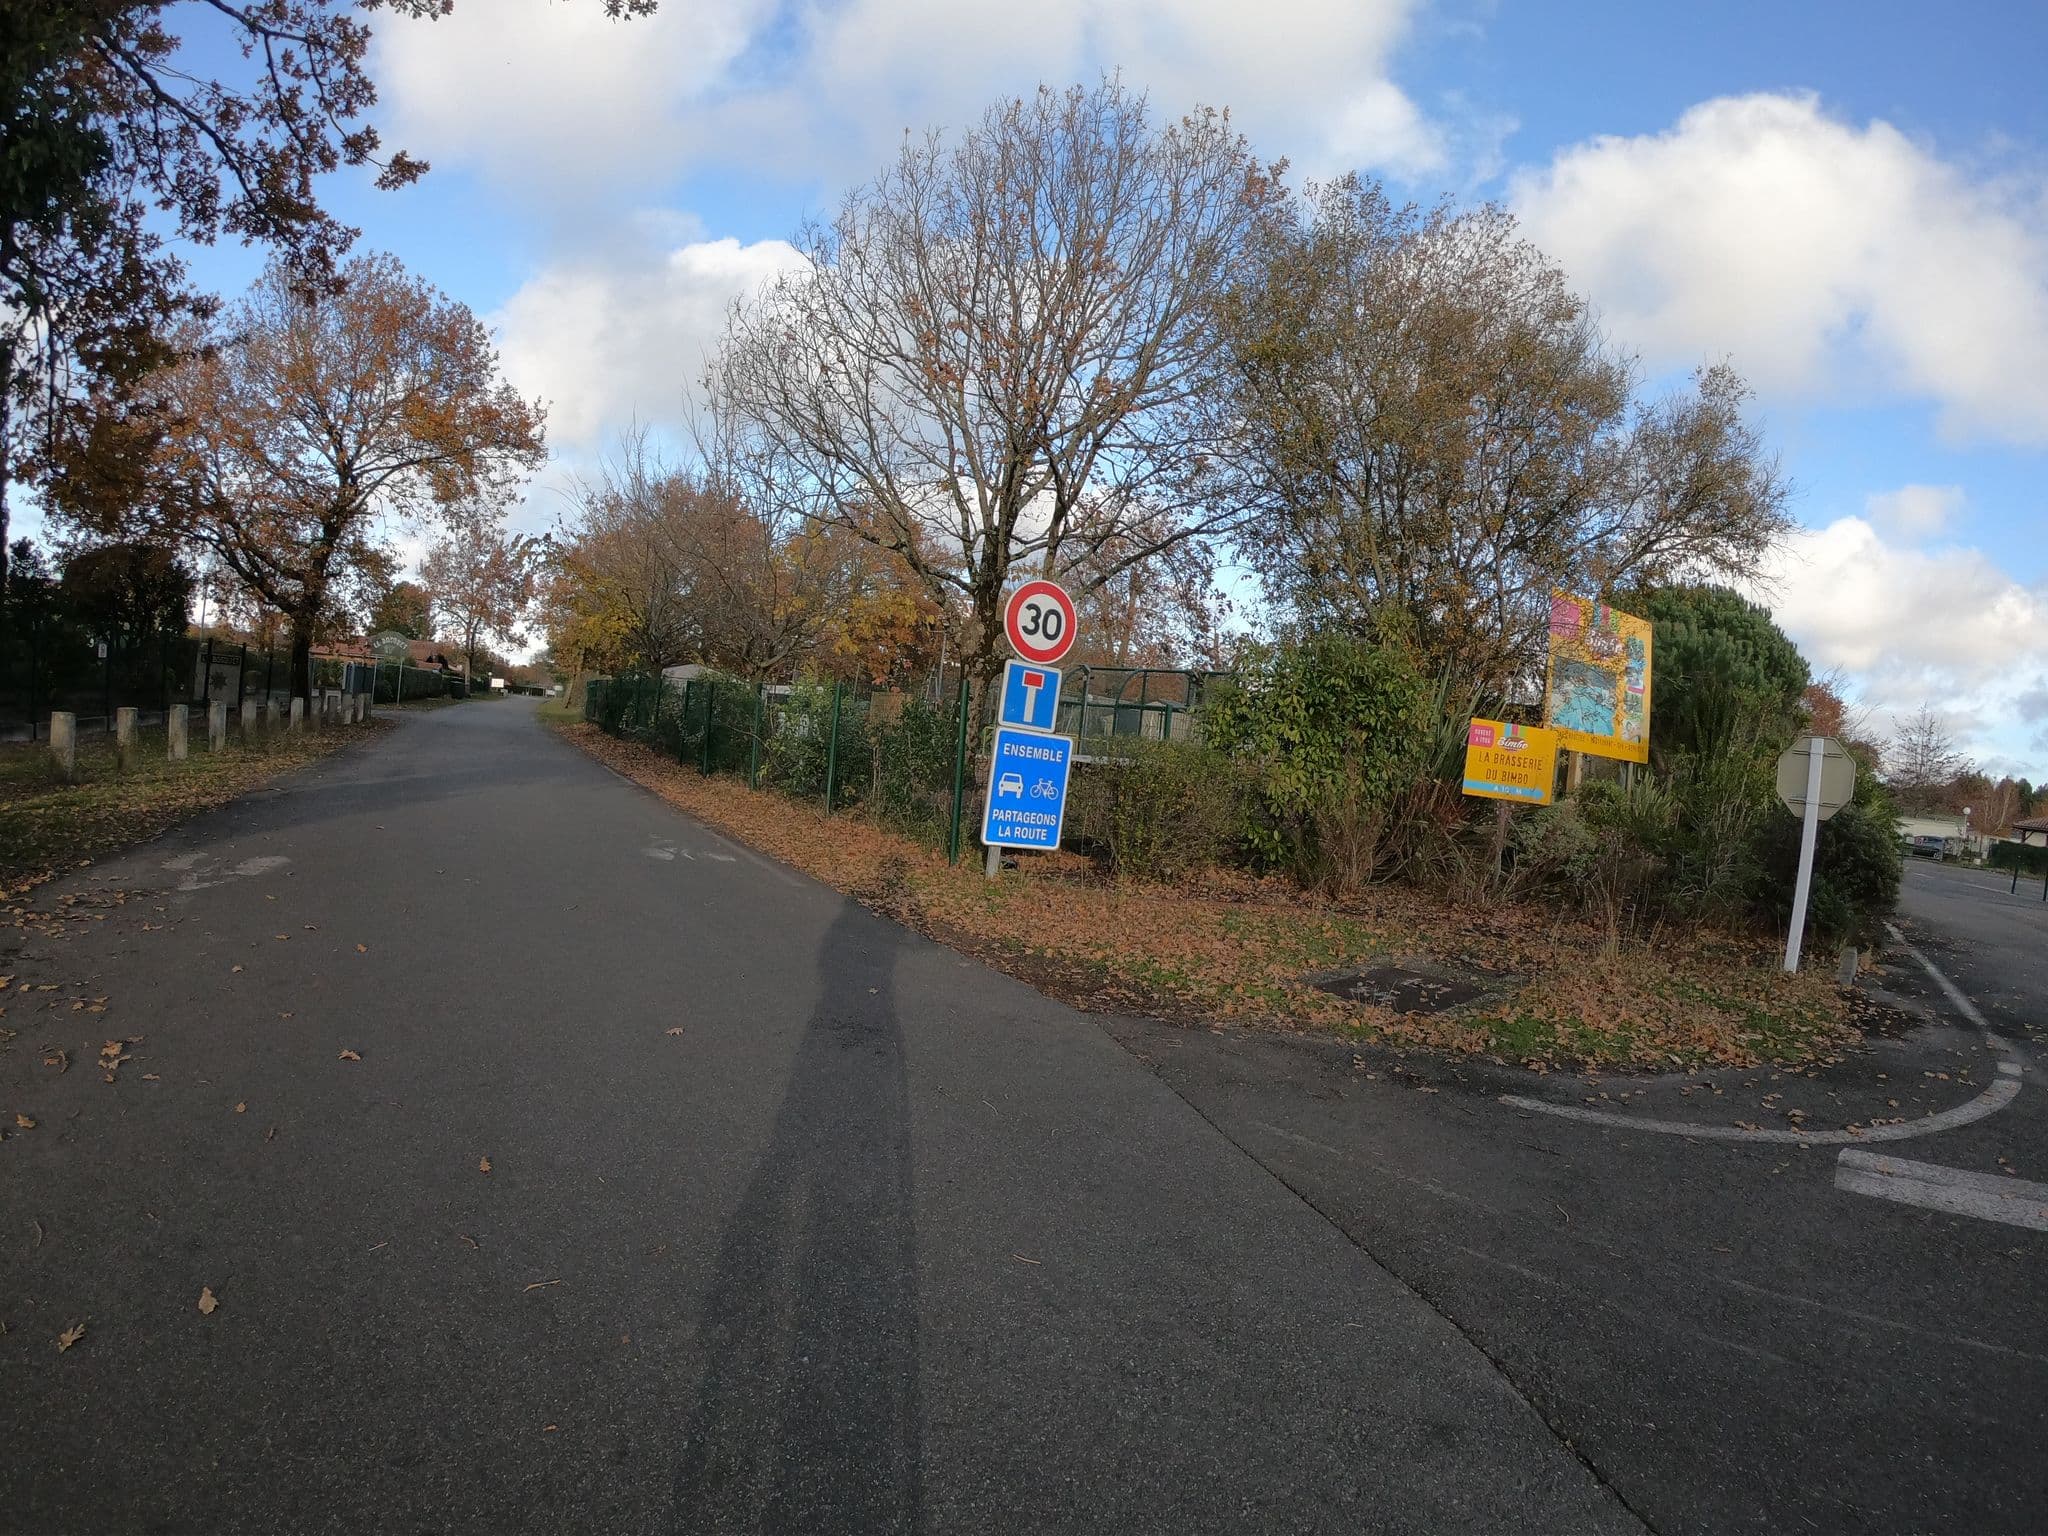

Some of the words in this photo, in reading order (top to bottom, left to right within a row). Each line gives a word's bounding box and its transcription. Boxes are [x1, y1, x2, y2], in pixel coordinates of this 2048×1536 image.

[1021, 603, 1062, 641] 30
[1003, 743, 1063, 762] ENSEMBLE
[1478, 751, 1490, 763] LA
[1493, 753, 1542, 770] BRASSERIE
[1485, 768, 1498, 781] DU
[1501, 770, 1529, 784] BIMBO
[992, 808, 1057, 826] PARTAGEONS
[998, 825, 1011, 838] LA
[1014, 826, 1048, 841] ROUTE
